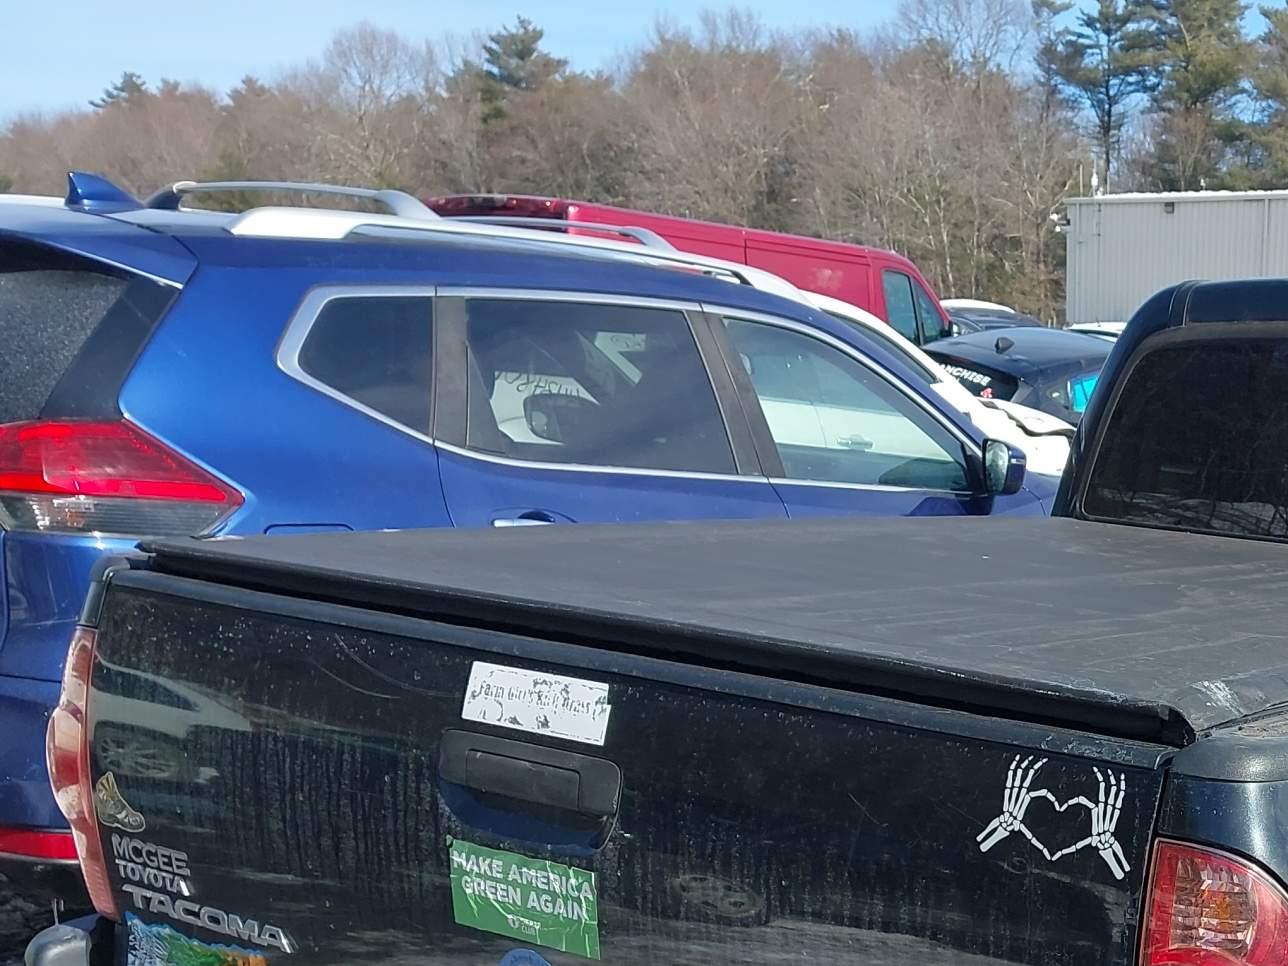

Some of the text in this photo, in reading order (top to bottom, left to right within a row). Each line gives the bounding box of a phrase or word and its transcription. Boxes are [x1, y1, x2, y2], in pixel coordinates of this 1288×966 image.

[939, 363, 992, 386] ANCHISE
[111, 832, 191, 877] MCGEE
[452, 850, 594, 901] MAKE AMERICA
[115, 858, 191, 897] TOYOTA
[461, 875, 588, 921] GREEN AGAIN
[121, 884, 296, 954] TACOMA
